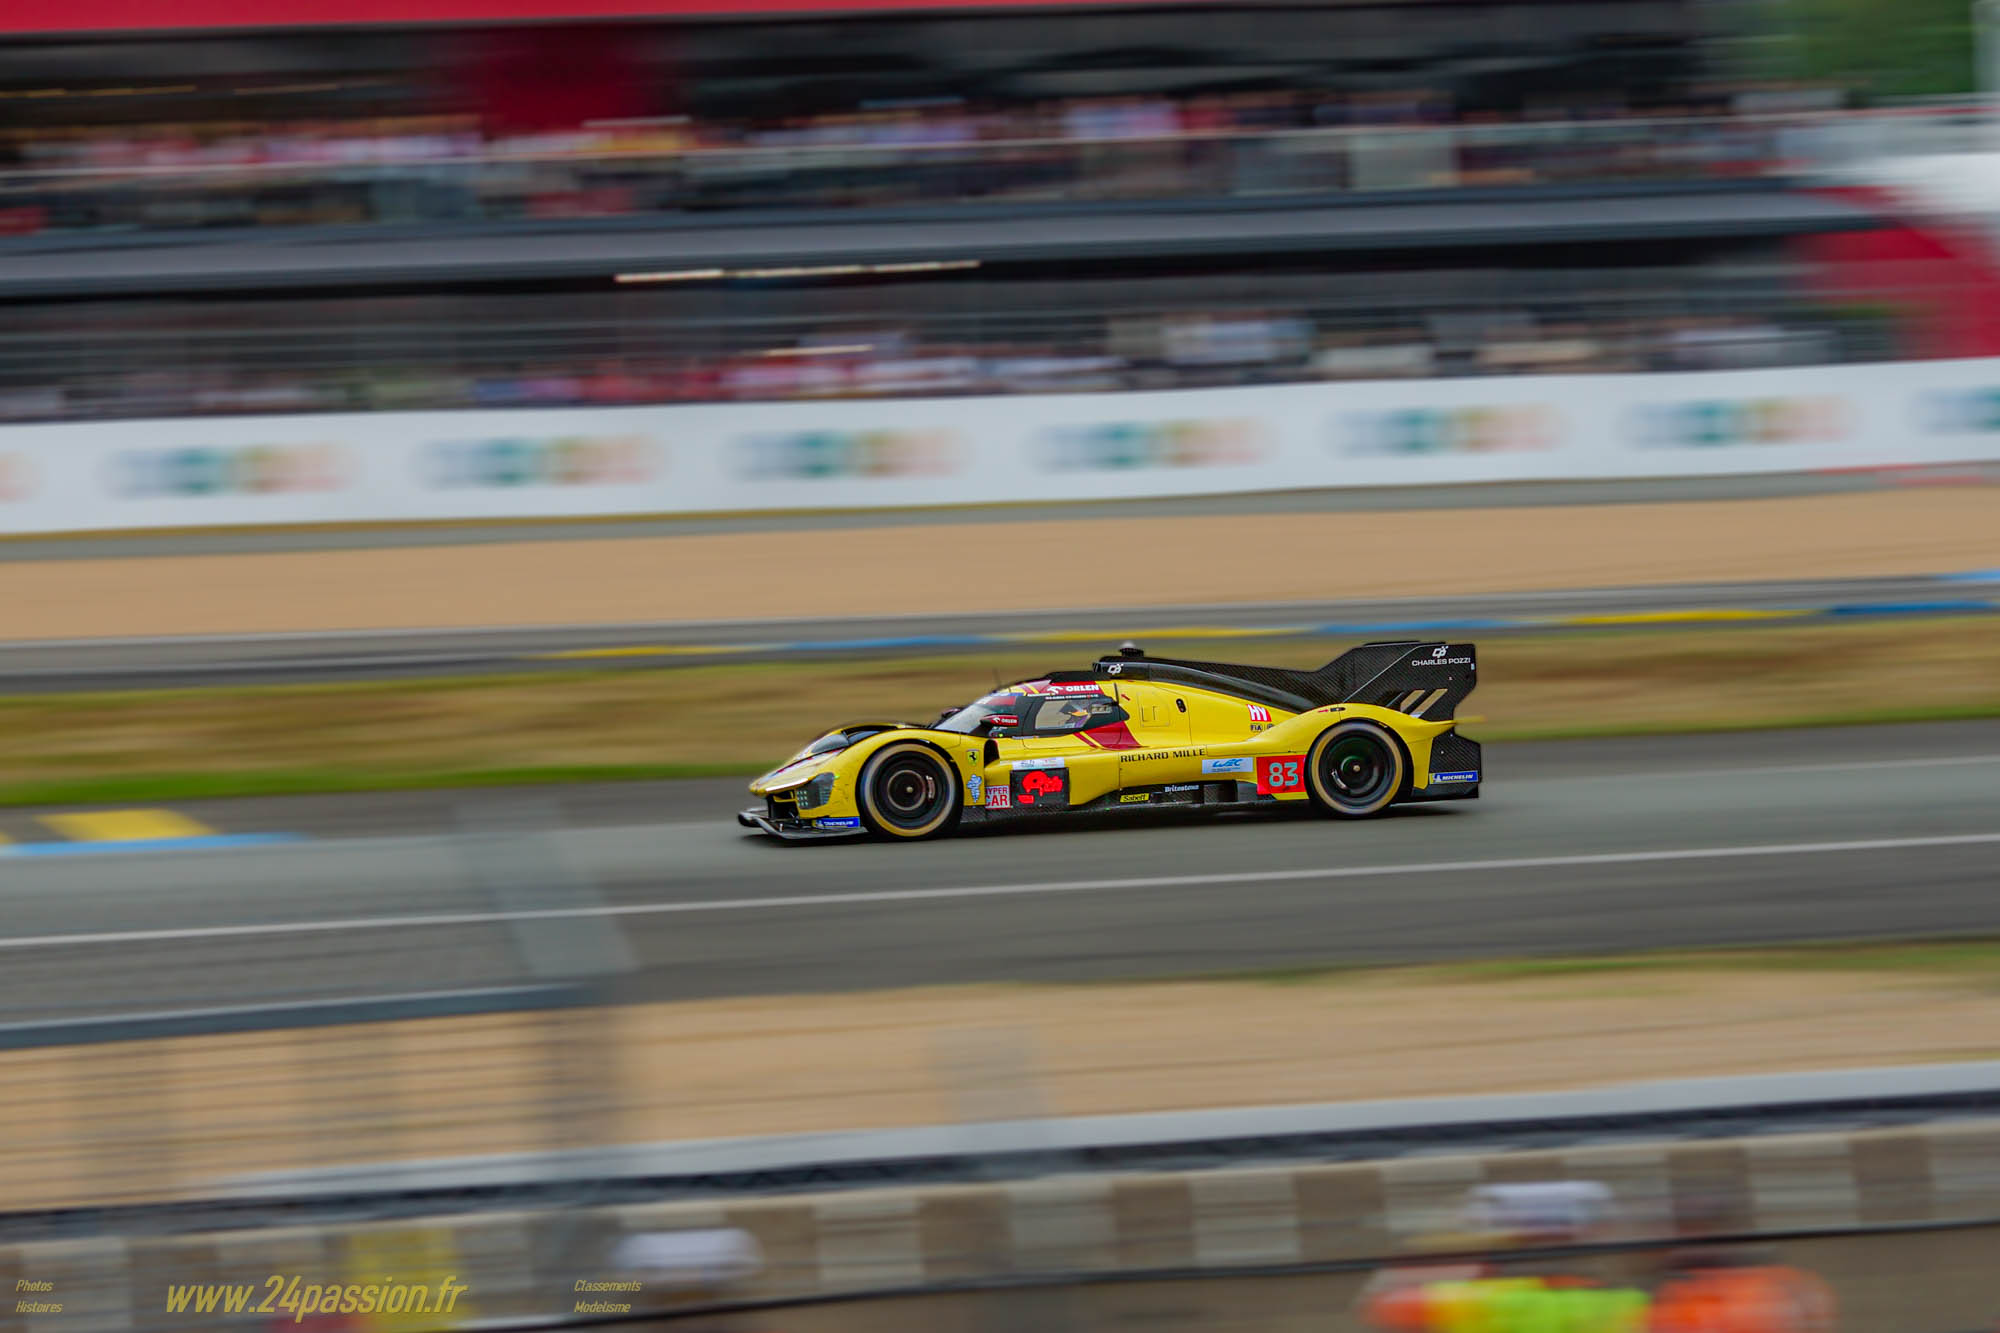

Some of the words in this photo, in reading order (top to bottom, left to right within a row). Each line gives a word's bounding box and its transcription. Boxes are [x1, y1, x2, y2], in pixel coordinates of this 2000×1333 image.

[1411, 659, 1447, 667] CHARLES
[1065, 684, 1100, 692] ORLEN
[1120, 751, 1169, 763] RICHARD
[1172, 748, 1206, 758] MILLE
[1269, 762, 1299, 787] 83
